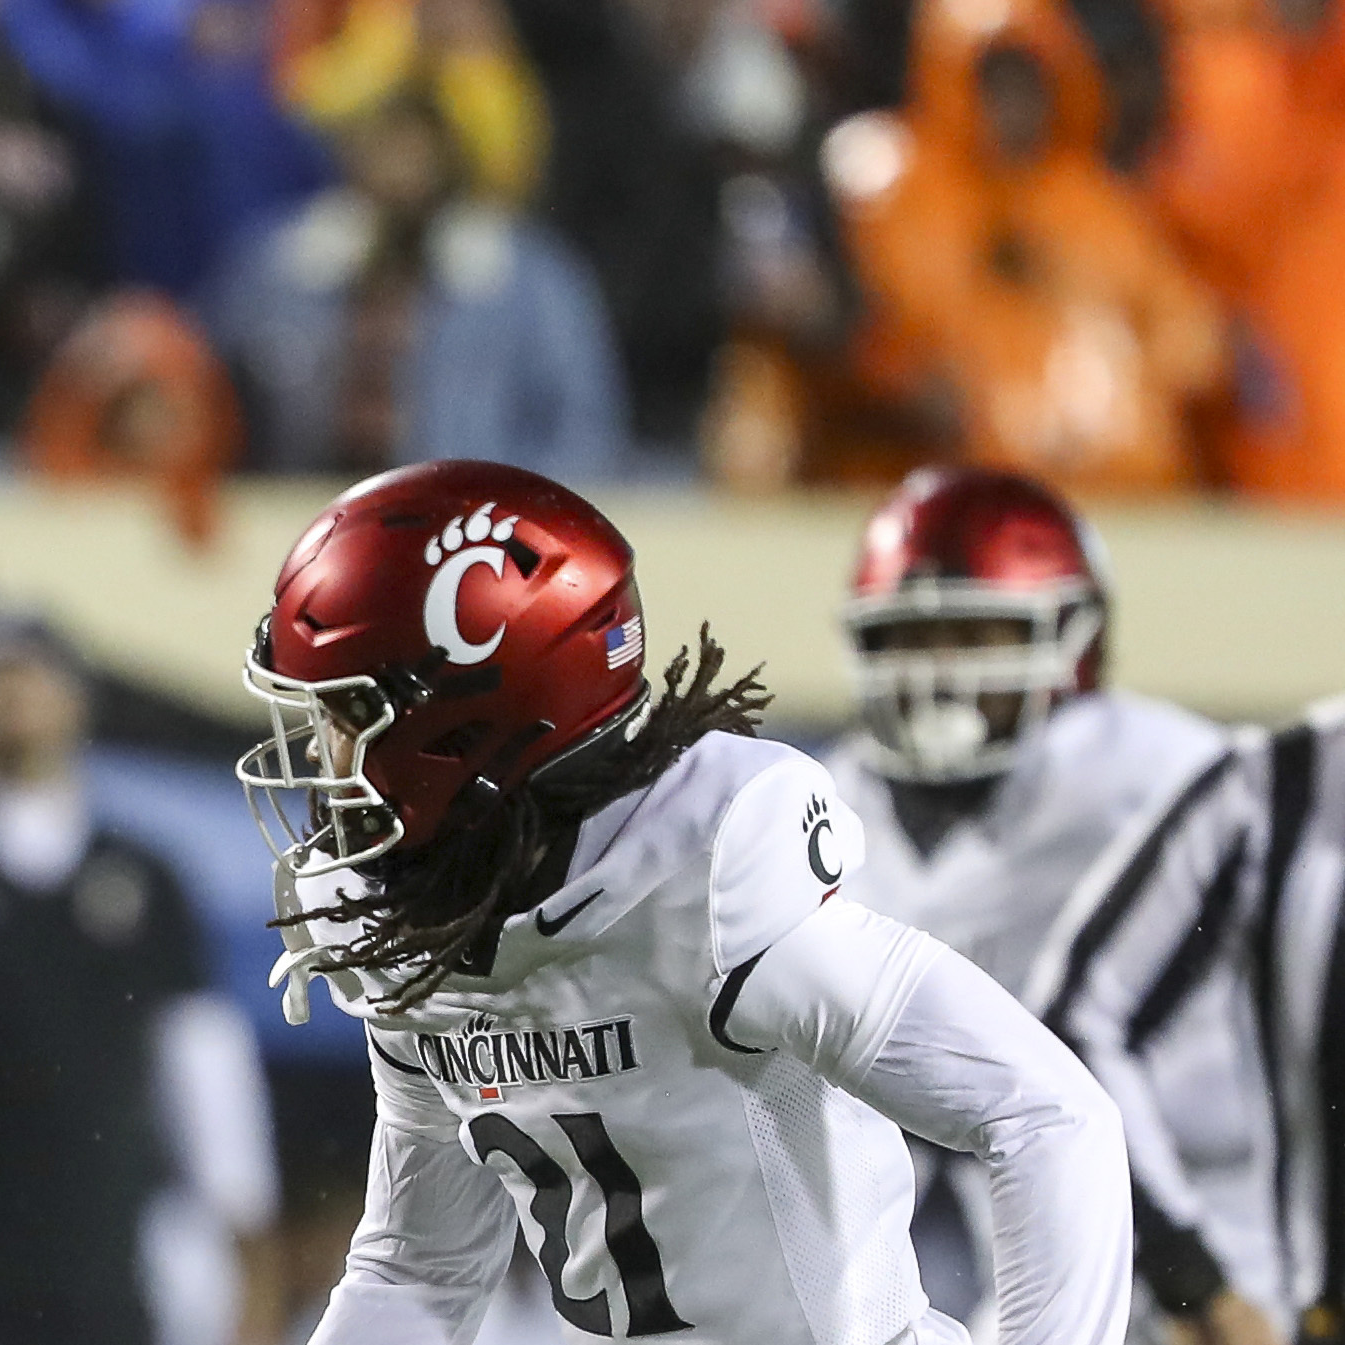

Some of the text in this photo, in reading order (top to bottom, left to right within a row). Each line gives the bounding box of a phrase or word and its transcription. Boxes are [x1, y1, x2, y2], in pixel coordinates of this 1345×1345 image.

[424, 525, 515, 666] C
[805, 806, 842, 885] C
[416, 1014, 642, 1087] CINCINNATI
[468, 1111, 696, 1338] 21
